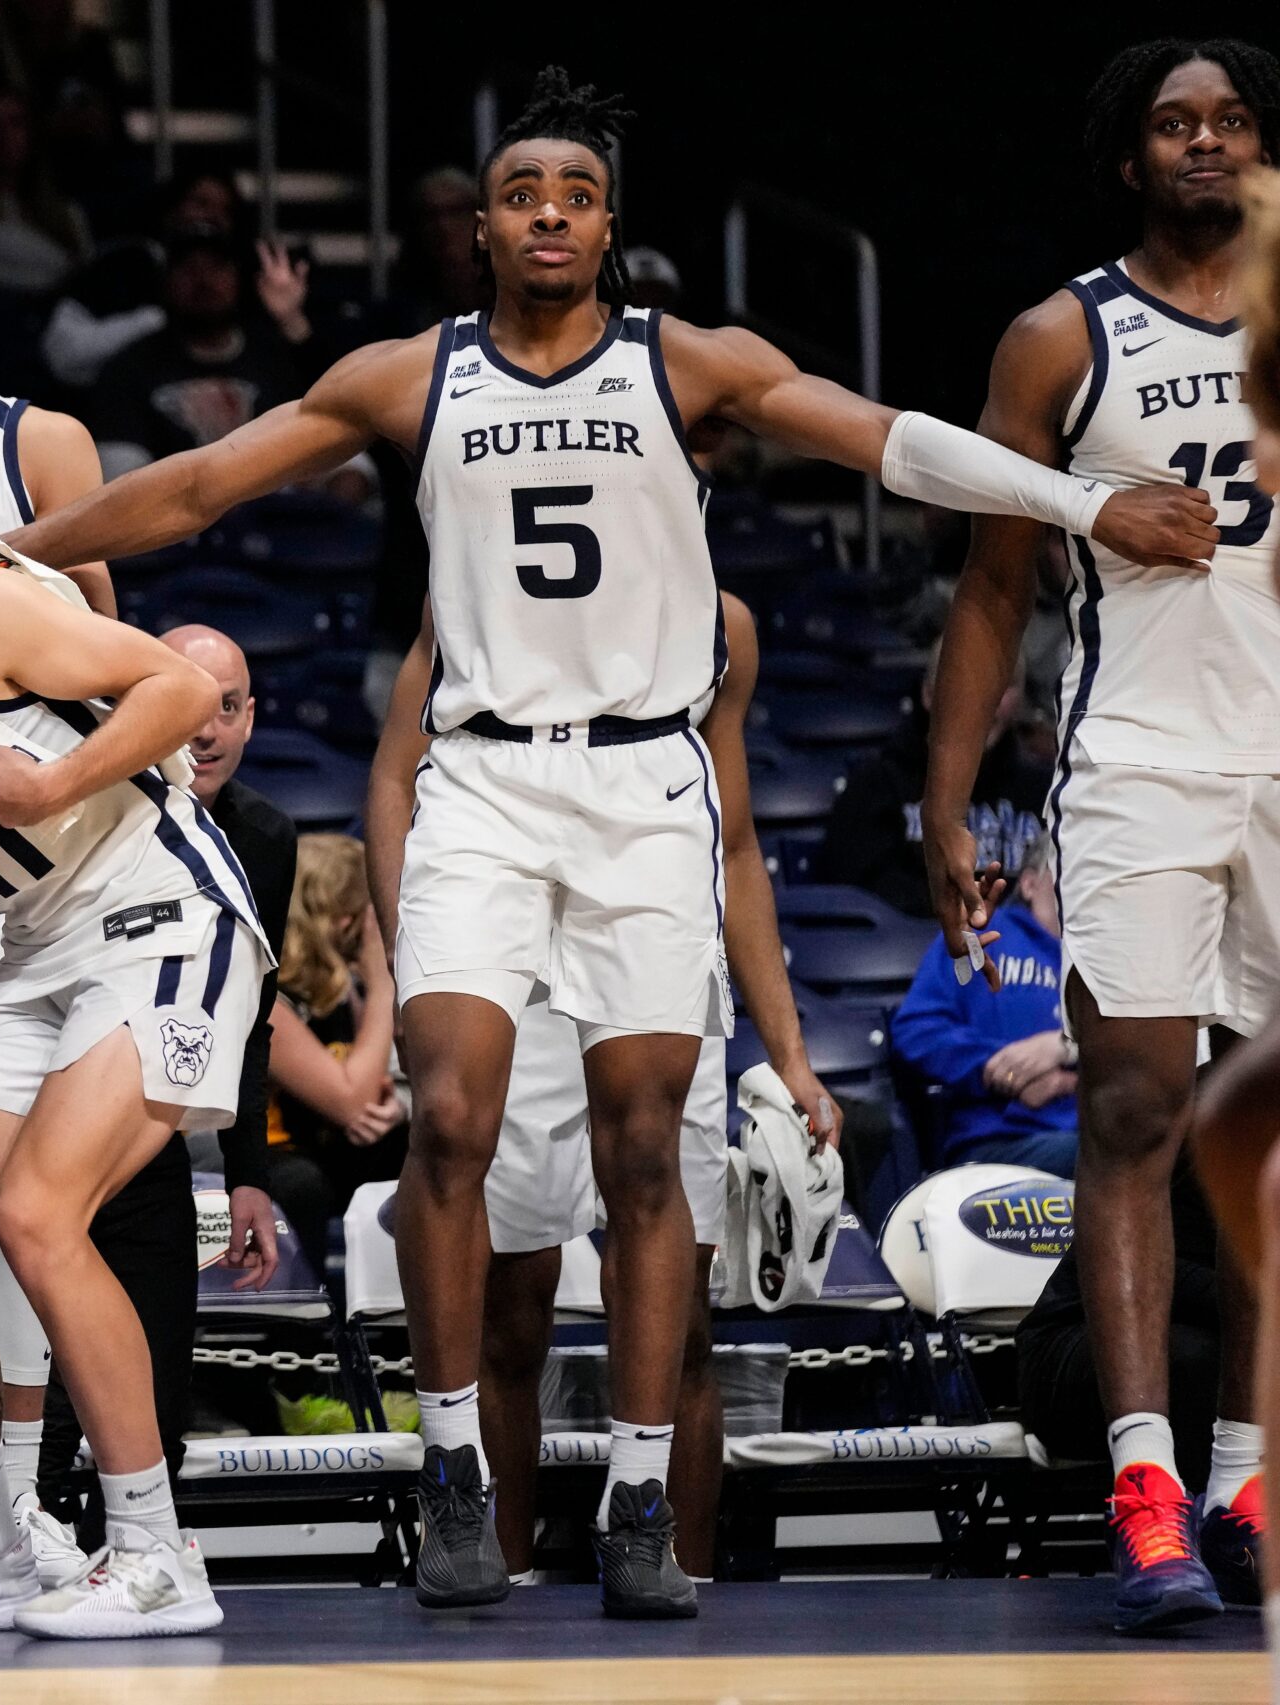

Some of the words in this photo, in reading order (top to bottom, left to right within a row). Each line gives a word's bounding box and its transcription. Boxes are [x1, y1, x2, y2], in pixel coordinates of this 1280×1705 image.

[1113, 318, 1150, 337] CHANGE
[1114, 317, 1126, 328] BE
[1127, 312, 1145, 325] THE
[449, 367, 482, 379] CHANGE
[454, 364, 466, 373] BE
[467, 360, 482, 371] THE
[596, 383, 636, 393] EAST
[601, 377, 628, 385] BIG
[461, 419, 644, 465] BUTLER
[1168, 440, 1275, 547] 13
[510, 484, 602, 600] 5
[156, 908, 170, 918] 44
[973, 1195, 1075, 1226] THIE
[831, 1435, 993, 1460] BULLDOGS
[219, 1446, 385, 1474] BULLDOGS
